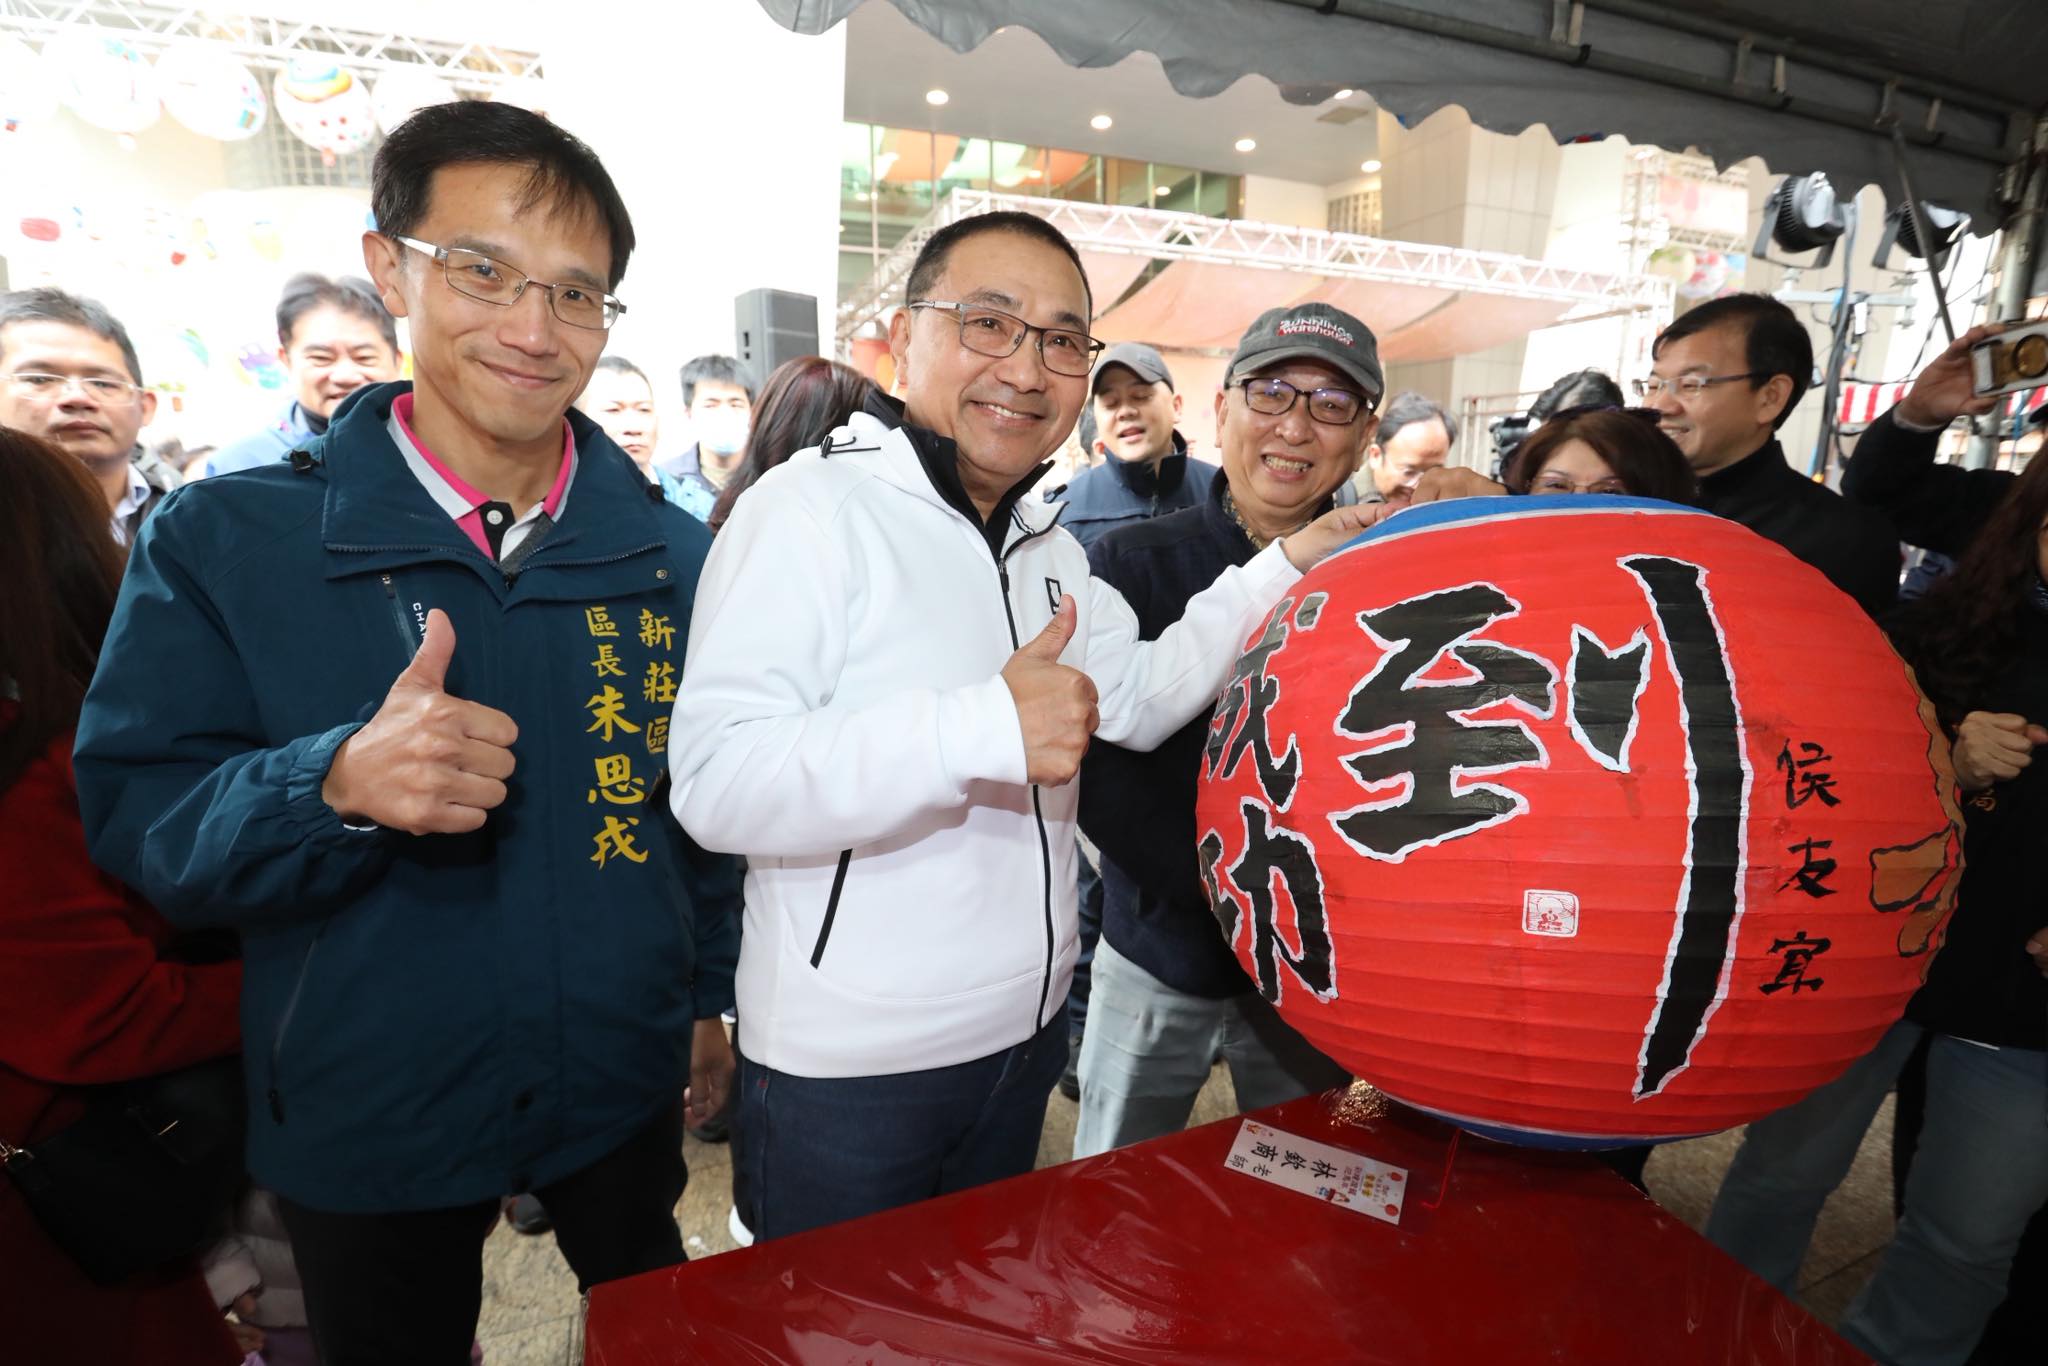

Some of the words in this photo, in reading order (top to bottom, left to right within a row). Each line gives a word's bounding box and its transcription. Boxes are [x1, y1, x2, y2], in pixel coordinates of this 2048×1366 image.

[638, 608, 677, 754] 新莊區
[1326, 552, 1753, 1104] 到
[1759, 738, 1841, 995] 侯友宜
